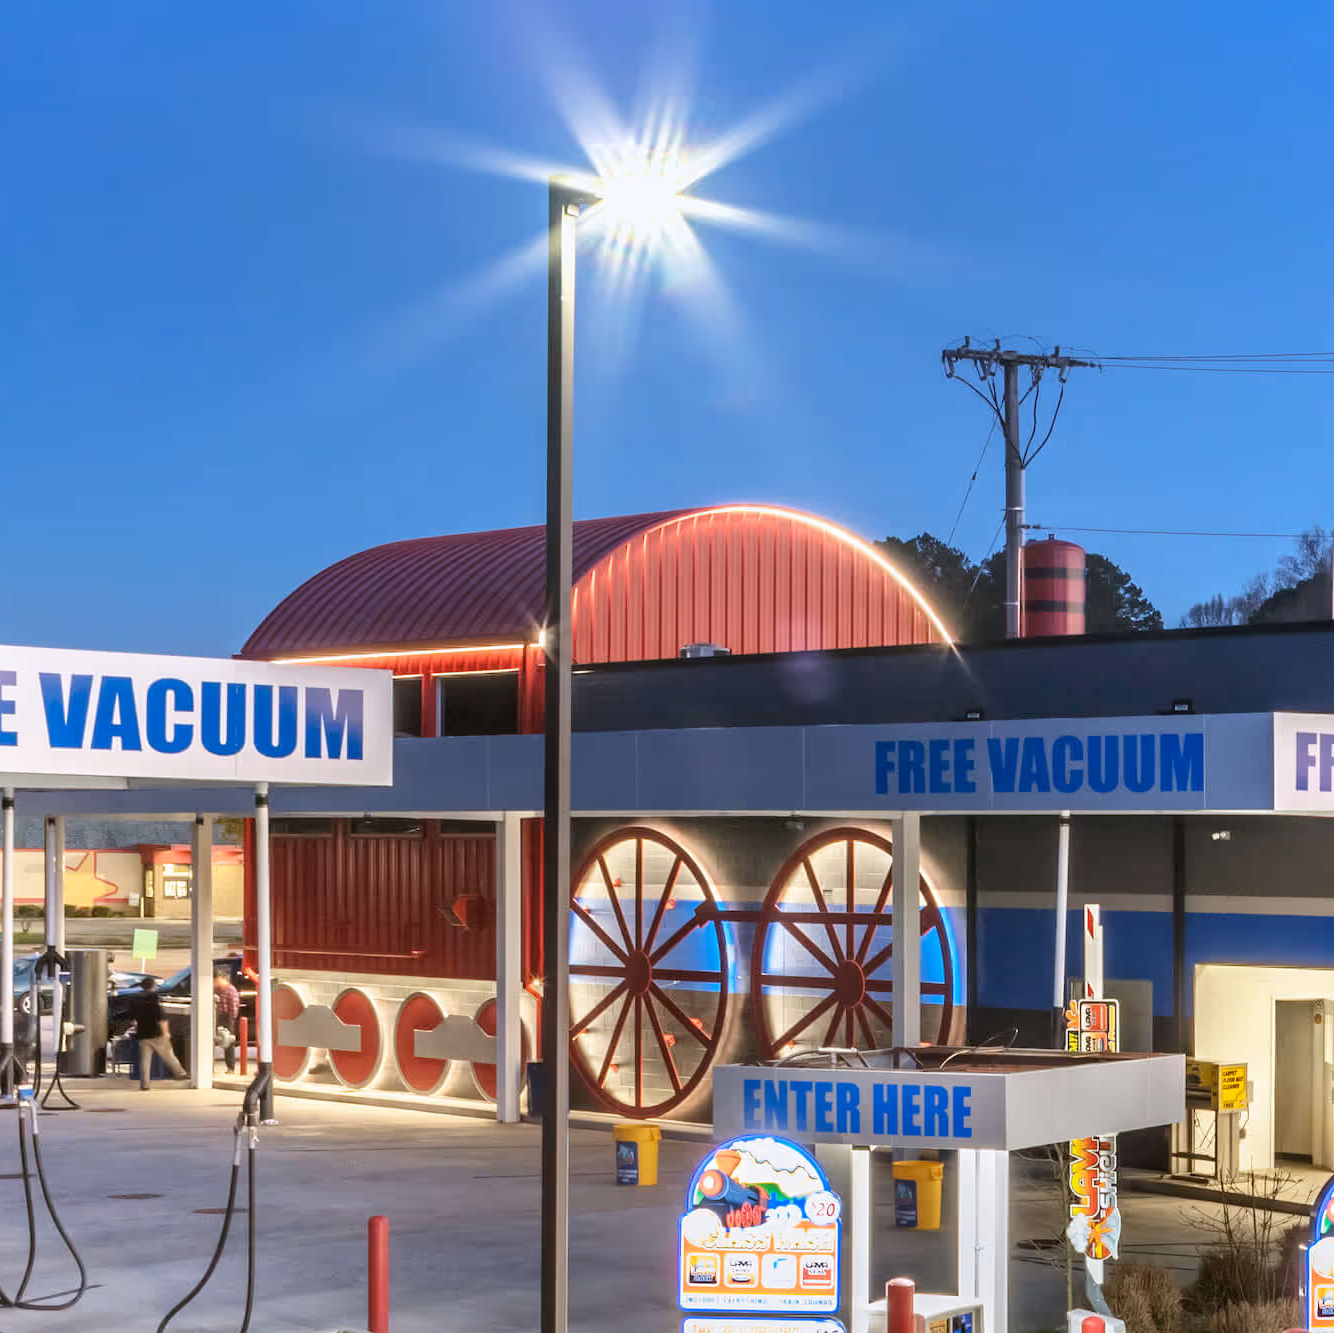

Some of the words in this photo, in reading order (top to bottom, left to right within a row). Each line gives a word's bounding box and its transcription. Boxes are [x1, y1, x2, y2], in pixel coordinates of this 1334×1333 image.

[38, 672, 365, 761] VACUUM
[874, 738, 977, 796] FREE
[985, 732, 1205, 794] VACUUM
[743, 1079, 861, 1134] ENTER
[872, 1083, 973, 1138] HERE
